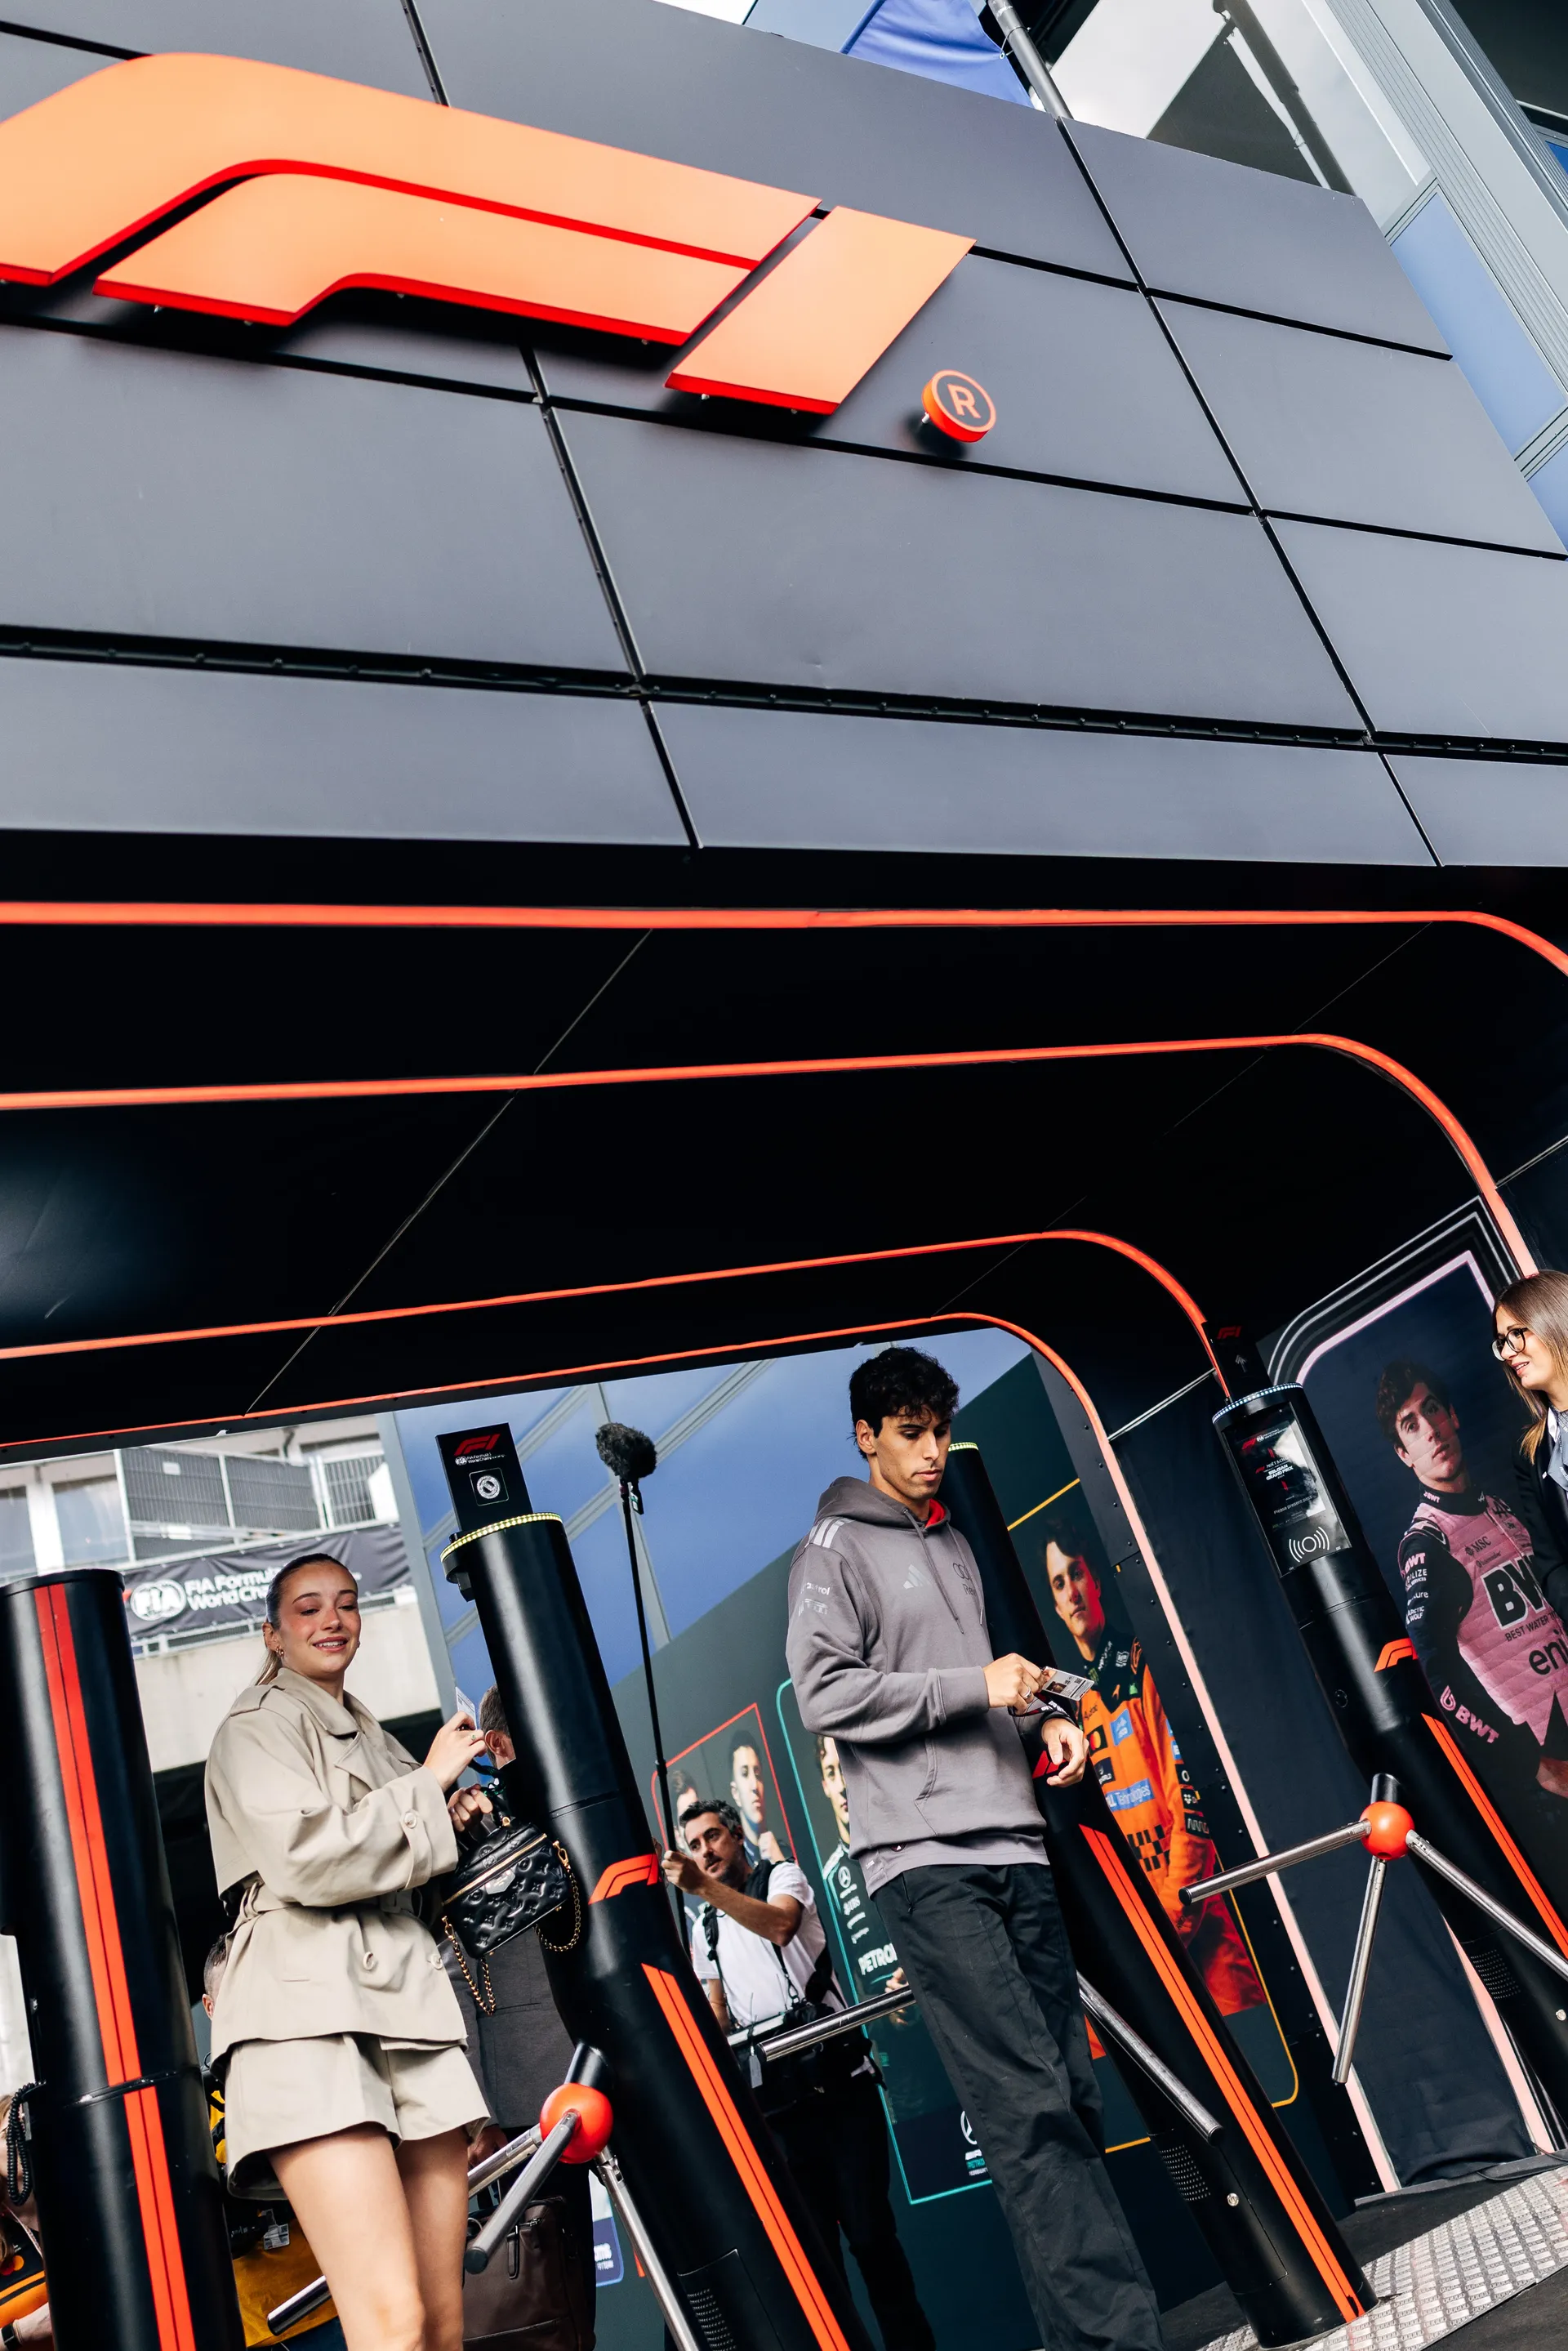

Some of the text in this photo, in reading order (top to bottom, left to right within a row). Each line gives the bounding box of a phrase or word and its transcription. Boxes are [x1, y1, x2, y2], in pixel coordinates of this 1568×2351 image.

[454, 1433, 501, 1456] F1
[1471, 1536, 1492, 1552] MSC
[185, 1577, 216, 1596] FIA
[800, 1582, 831, 1596] astrol
[187, 1589, 240, 1611] World
[1505, 1626, 1526, 1642] BEST
[1526, 1614, 1550, 1632] WATER
[1455, 1704, 1499, 1744] BWT
[588, 1854, 659, 1906] F1
